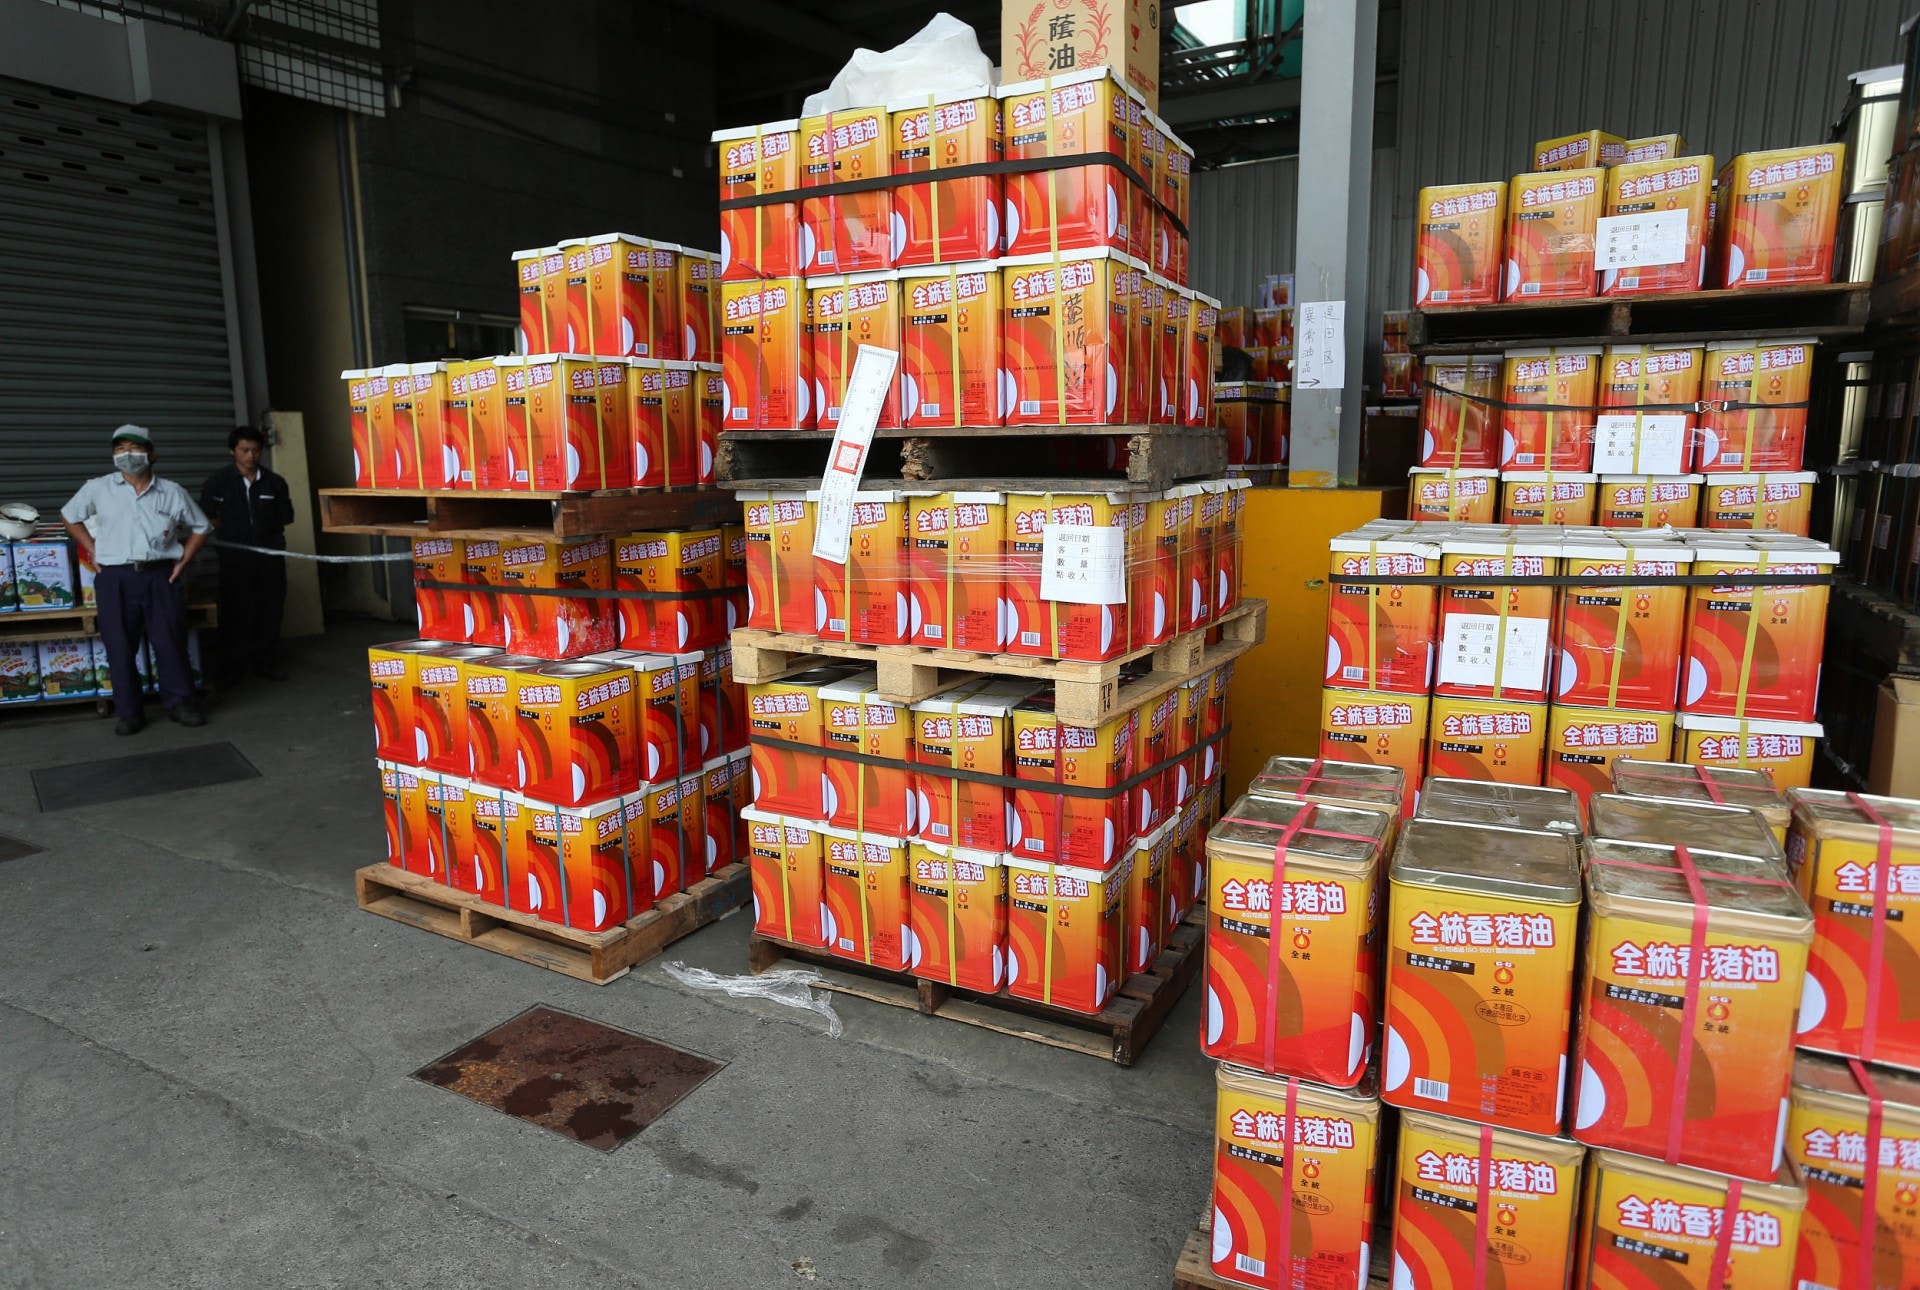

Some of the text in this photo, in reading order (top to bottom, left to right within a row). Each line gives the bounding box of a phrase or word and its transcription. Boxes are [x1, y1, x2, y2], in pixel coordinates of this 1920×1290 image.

[1048, 13, 1076, 70] 蔭油
[900, 100, 977, 142] 全統香豬油
[1538, 138, 1588, 166] 全統香豬油
[1620, 164, 1699, 199] 全統香豬油
[1748, 153, 1834, 188] 全統香豬油
[1521, 177, 1595, 207] 全統香豬油
[1429, 190, 1497, 218] 全統香豬油
[819, 282, 887, 316] 全統香豬油
[1301, 306, 1316, 374] 異常油品
[1614, 351, 1692, 379] 全統香豬油
[1721, 346, 1805, 375] 全統香豬油
[747, 501, 805, 526] 全統香豬油
[1059, 533, 1090, 543] 退回日期
[502, 543, 546, 565] 全統香豬油
[619, 538, 667, 561] 全統香豬油
[681, 536, 720, 563] 全統香豬油
[1058, 546, 1089, 555] 客戶
[1056, 558, 1088, 568] 數量
[1460, 633, 1492, 642] 客戶
[1461, 622, 1494, 631] 退回日期
[1458, 644, 1491, 654] 數量
[371, 660, 405, 676] 全統香豬油
[421, 666, 458, 684] 全統香豬油
[467, 676, 507, 694] 全統香豬油
[519, 685, 562, 704] 全統香豬油
[577, 675, 630, 711] 全統香豬油
[1102, 683, 1113, 700] TP
[753, 693, 809, 714] 全統香豬油
[1103, 700, 1111, 713] 14
[1330, 704, 1412, 726] 全統香豬油
[1443, 712, 1531, 736] 全統香豬油
[1563, 723, 1658, 747] 全統香豬油
[1410, 911, 1556, 948] 全統香豬油
[1290, 950, 1311, 961] 全統
[1491, 985, 1514, 997] 全統
[1703, 1021, 1729, 1034] 全統
[1300, 1178, 1321, 1190] 全統
[1494, 1225, 1517, 1238] 全統
